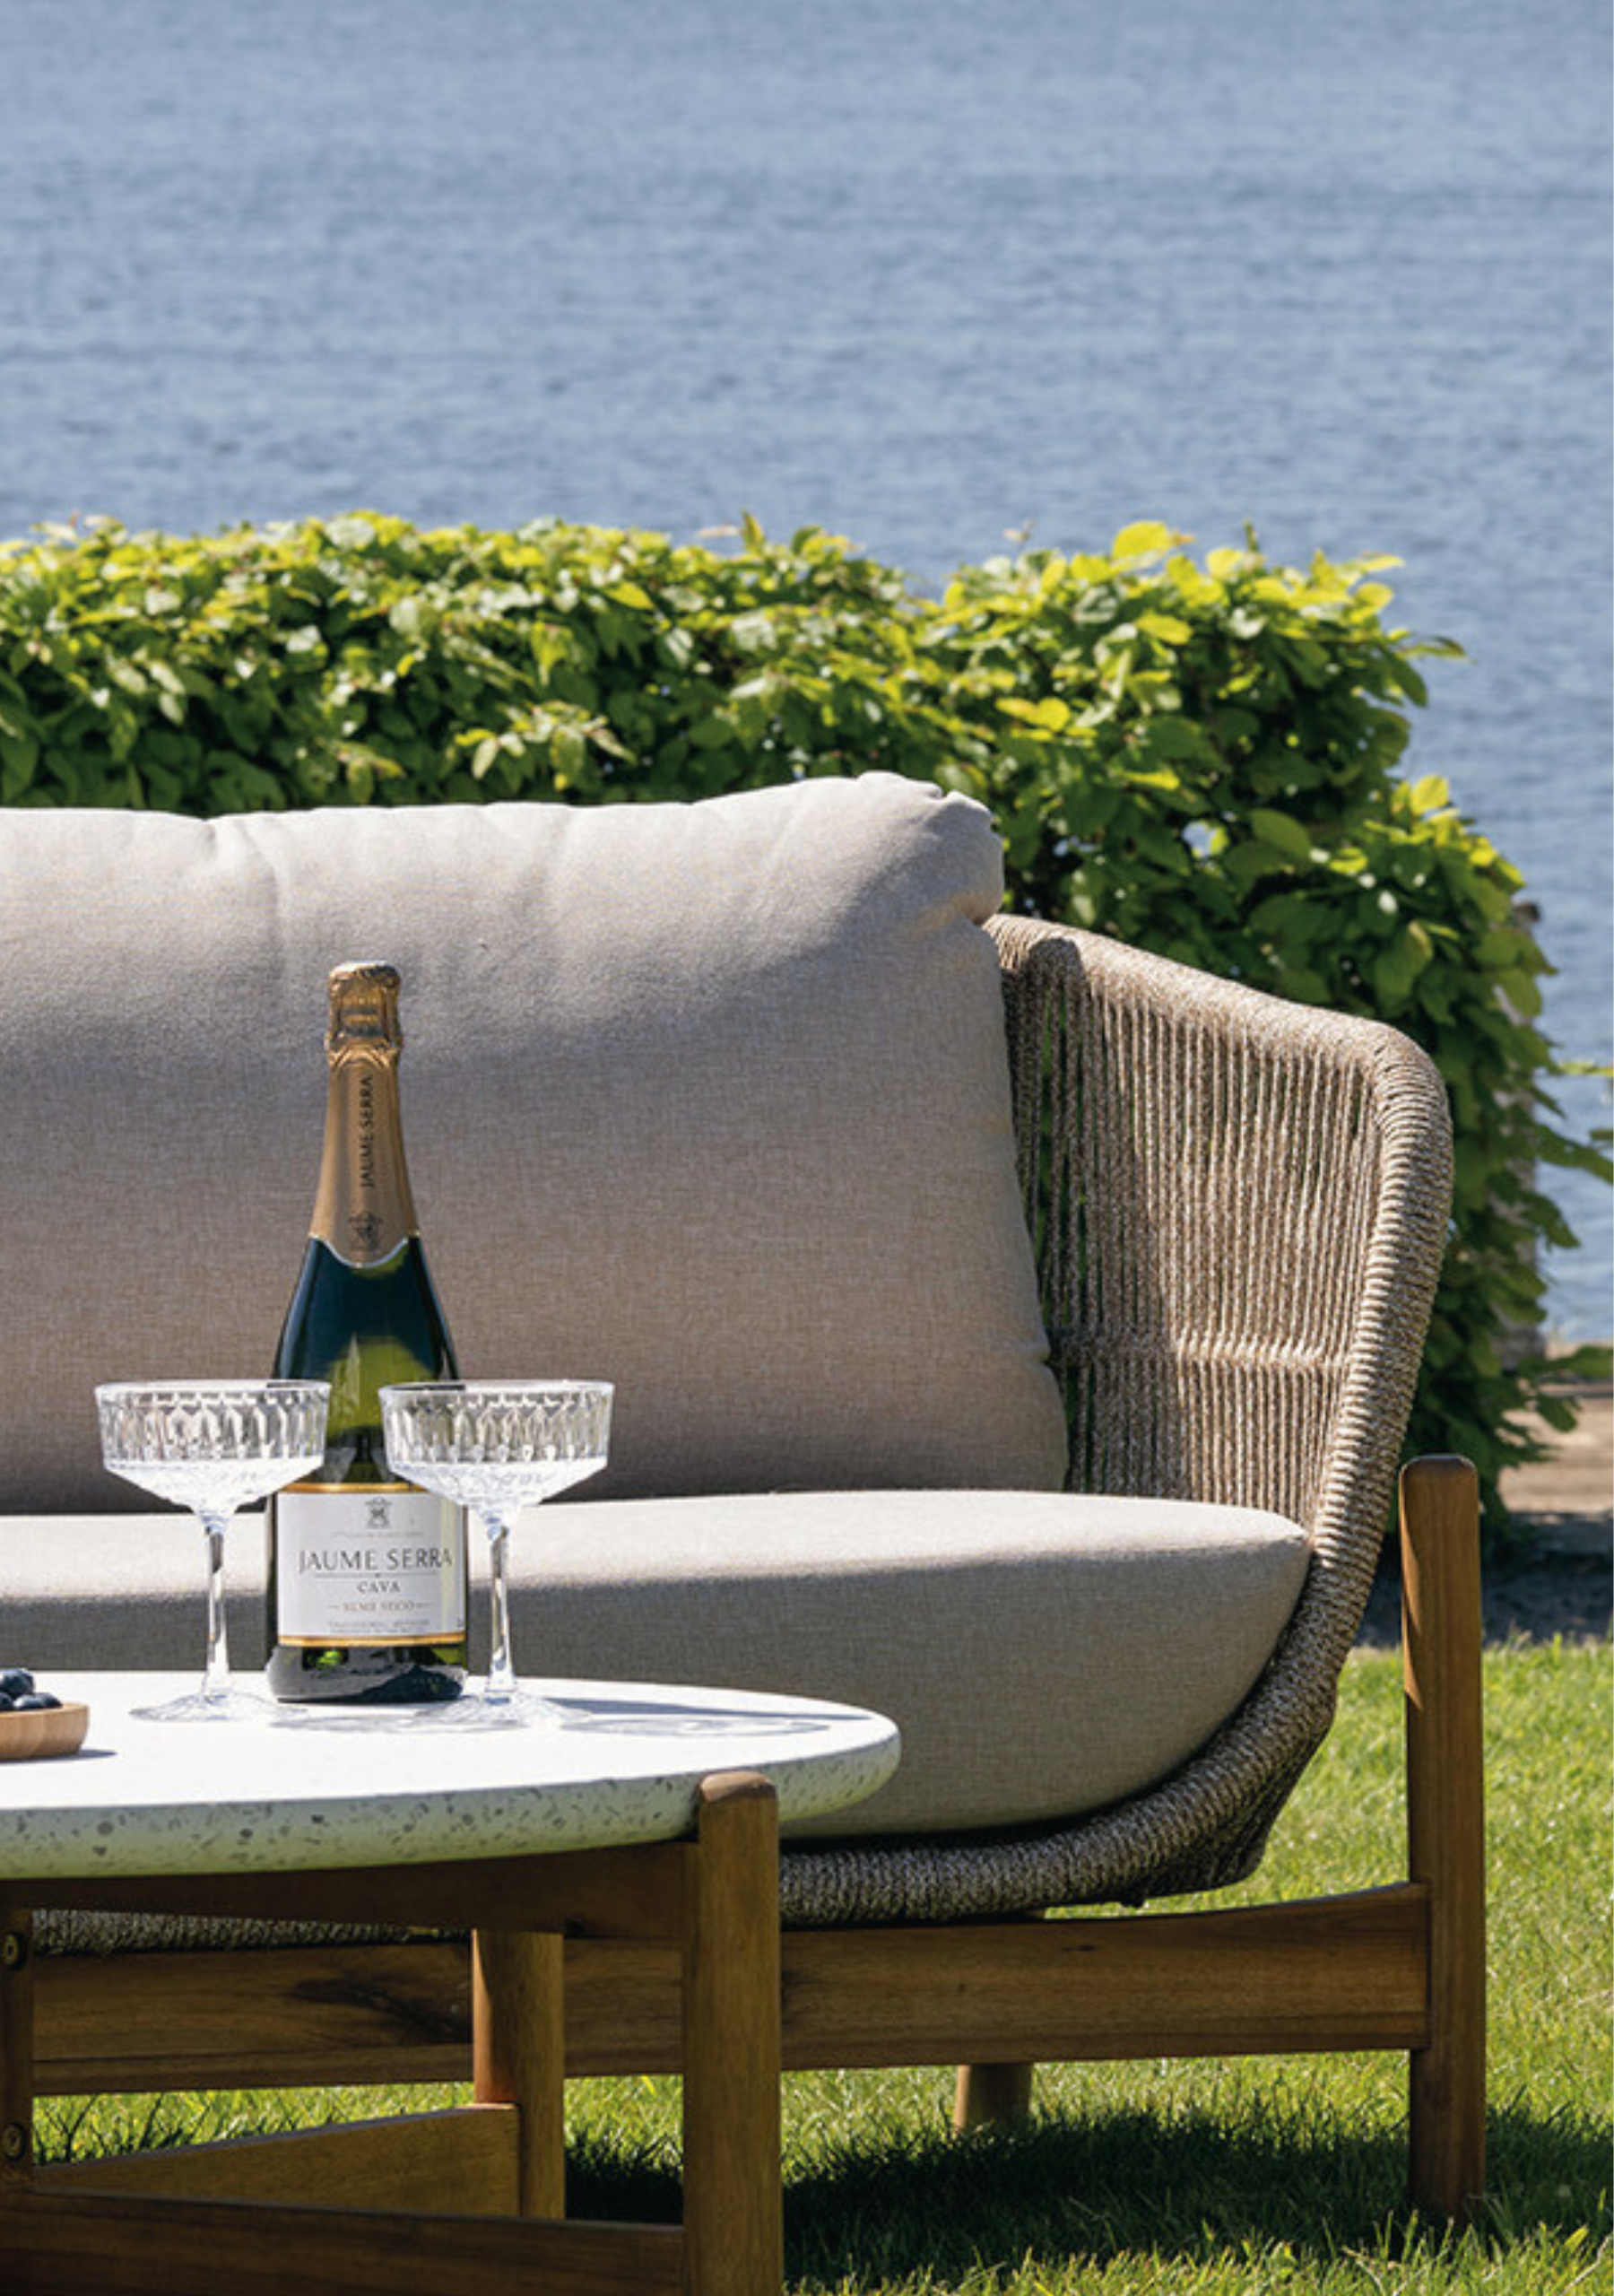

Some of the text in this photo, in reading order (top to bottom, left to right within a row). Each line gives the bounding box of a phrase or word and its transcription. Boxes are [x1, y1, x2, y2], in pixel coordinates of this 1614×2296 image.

[360, 1075, 374, 1187] JAUME SERRA
[299, 1548, 453, 1573] JAUME SERRA
[357, 1580, 401, 1593] CAVA
